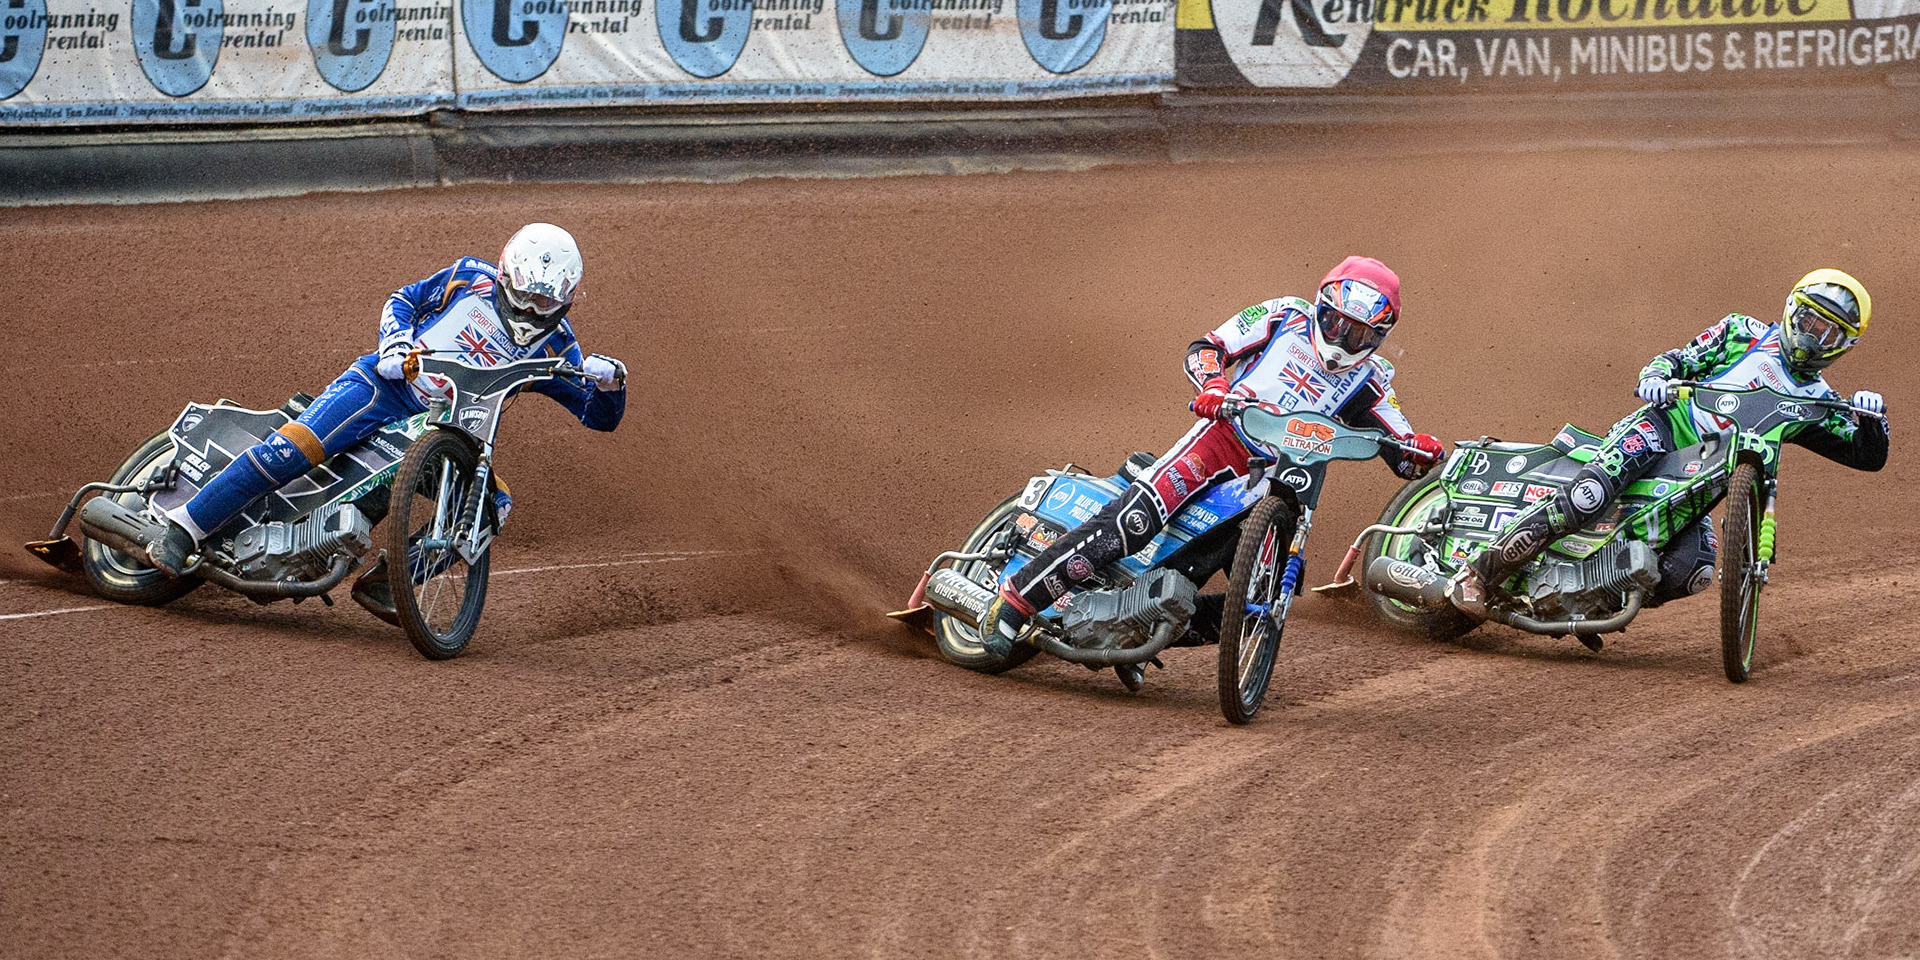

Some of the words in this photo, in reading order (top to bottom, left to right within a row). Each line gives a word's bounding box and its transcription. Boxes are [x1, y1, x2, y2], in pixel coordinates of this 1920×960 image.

[569, 16, 628, 34] rental
[753, 13, 812, 31] rental
[932, 13, 993, 30] rental
[47, 31, 105, 50] rental
[222, 30, 284, 48] rental
[1386, 37, 1469, 83] CAR,
[1476, 37, 1561, 83] VAN,
[1571, 32, 1715, 75] MINIBUS
[1722, 31, 1746, 72] &
[470, 309, 497, 335] SPORTS
[493, 330, 517, 356] INSURE
[1290, 345, 1317, 368] SPORTS
[1314, 362, 1340, 386] INSURE
[1331, 364, 1364, 404] FINAL
[1760, 363, 1782, 390] SPORTS
[1281, 393, 1296, 408] 15
[460, 409, 489, 421] LAWSON
[1282, 436, 1331, 454] FILTRATION
[1284, 474, 1306, 486] ATPI
[1024, 480, 1048, 506] 3
[1579, 485, 1598, 506] ATPI
[1074, 494, 1092, 511] BLUE
[1131, 513, 1145, 532] ATPI
[934, 583, 958, 601] 01912
